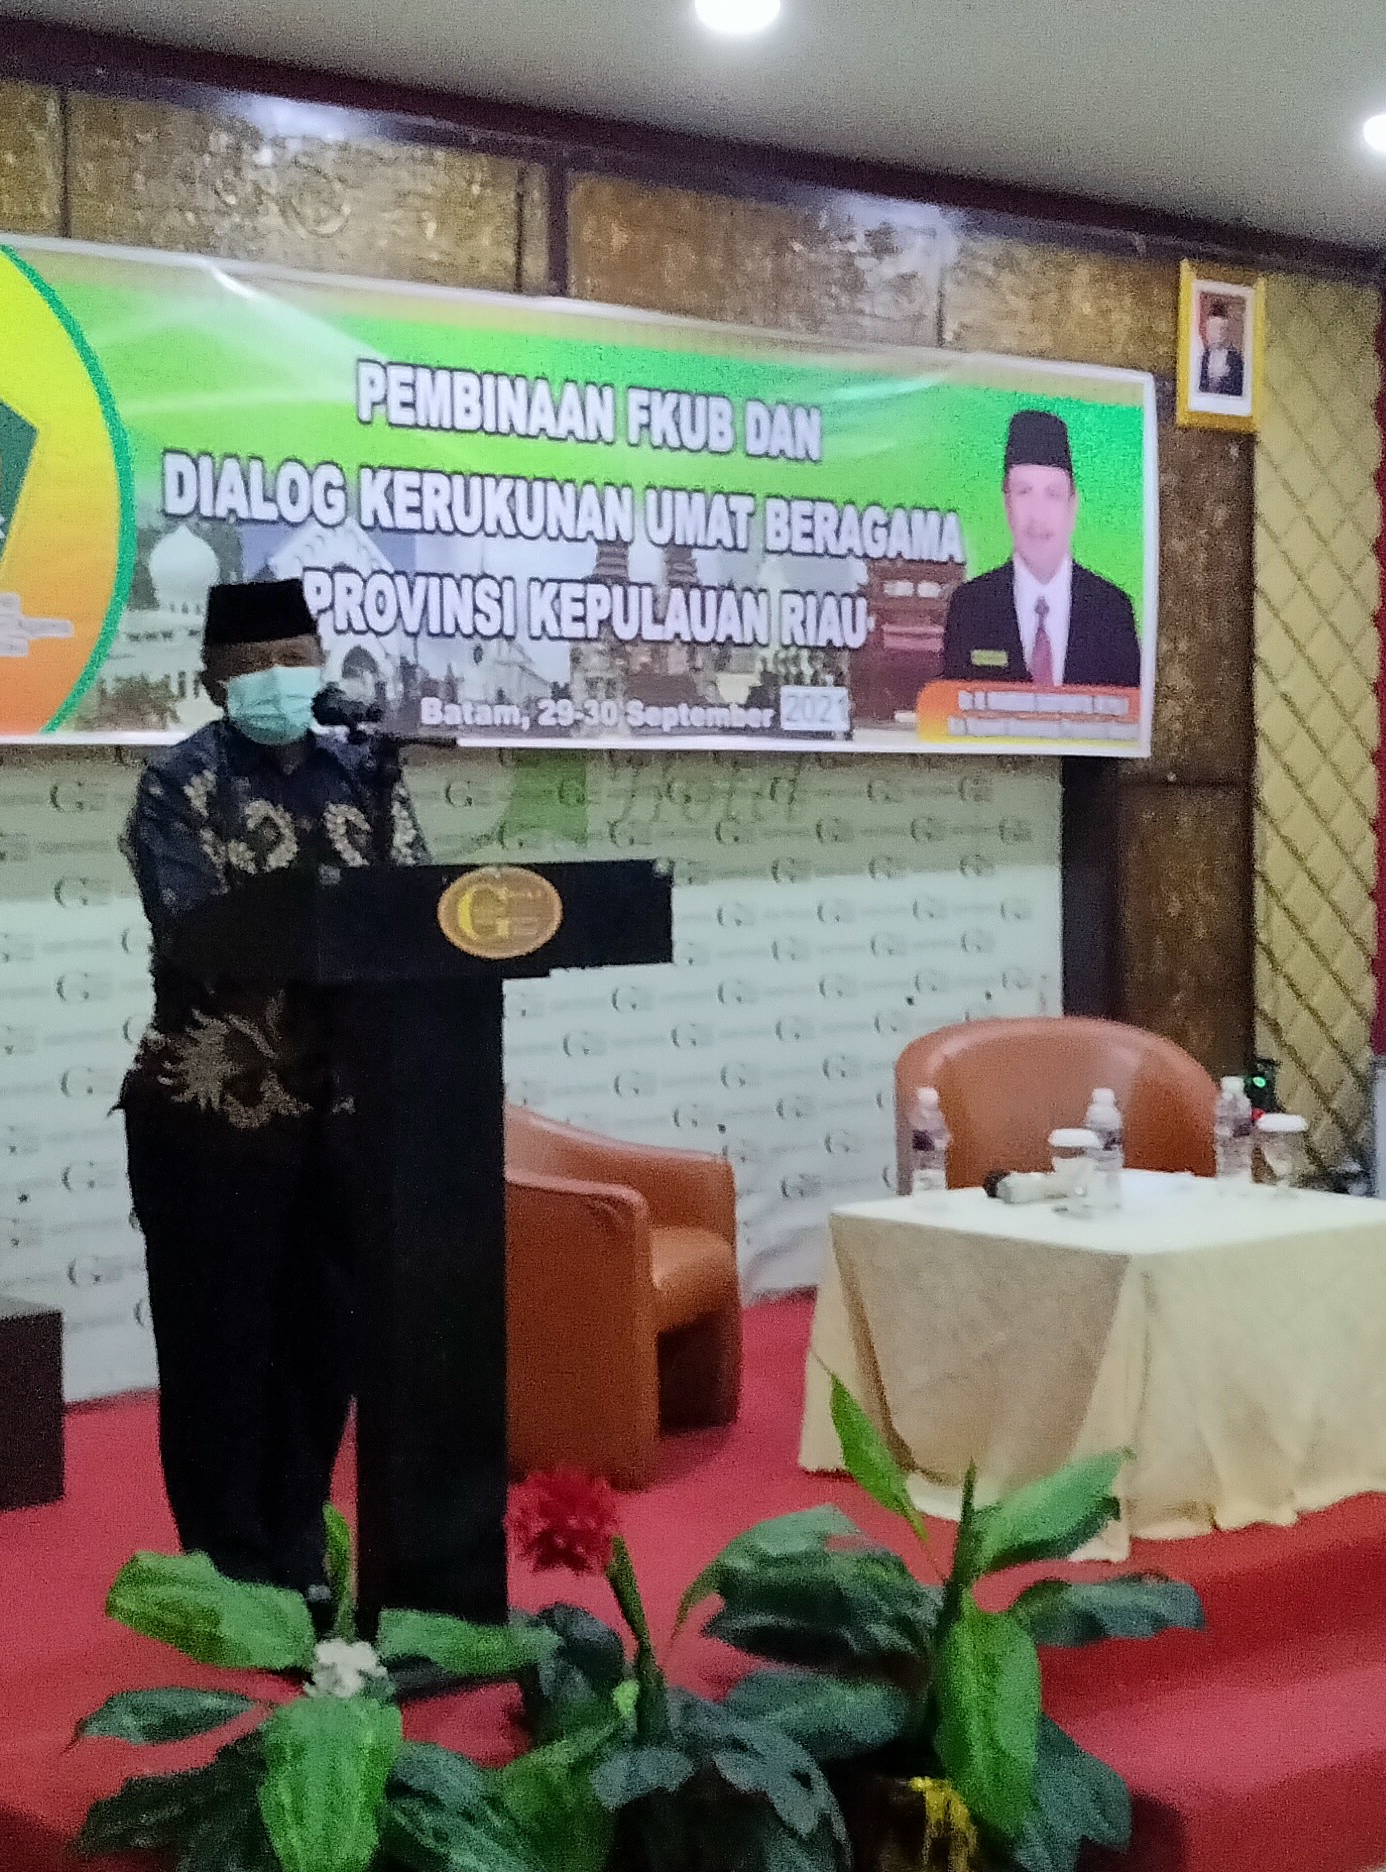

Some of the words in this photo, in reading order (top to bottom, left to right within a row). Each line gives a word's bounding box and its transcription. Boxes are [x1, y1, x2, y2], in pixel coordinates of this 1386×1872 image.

[356, 358, 615, 444] PEMBINAAN
[627, 385, 735, 454] FKUB
[745, 398, 822, 464] DAN
[162, 448, 348, 527] DIALOG
[359, 464, 635, 544] KERUKUNAN
[644, 485, 756, 552] UMAT
[764, 495, 967, 564] BERAGAMA
[303, 567, 516, 639] PROVINSI
[528, 577, 770, 647] KEPULAUAN
[781, 589, 868, 650] RIAU
[419, 697, 530, 730] Batam,
[538, 699, 619, 727] 29-30
[625, 699, 775, 733] September
